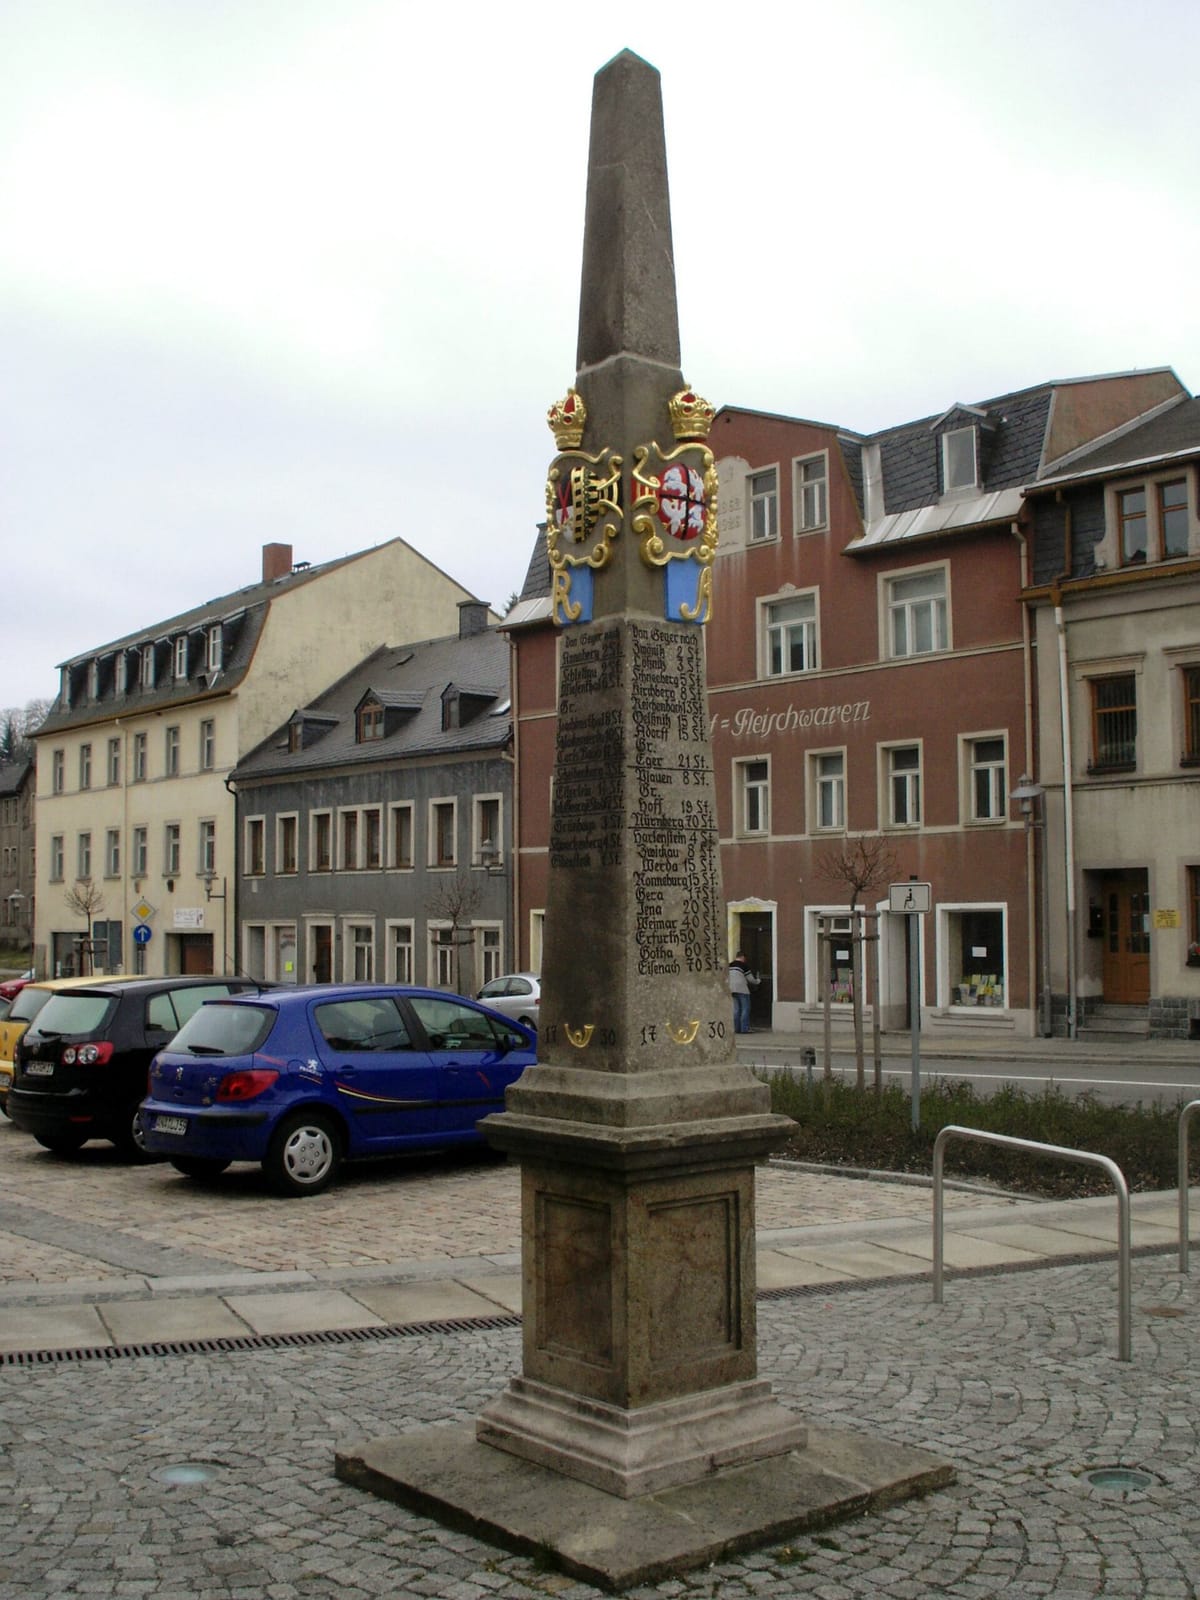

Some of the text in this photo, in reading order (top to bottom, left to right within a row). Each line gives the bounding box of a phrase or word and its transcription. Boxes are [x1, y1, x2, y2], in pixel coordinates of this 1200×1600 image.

[631, 624, 648, 639] Von
[651, 628, 678, 645] Geyer
[677, 645, 683, 658] 2
[687, 646, 701, 660] St.
[677, 658, 683, 672] 3
[687, 659, 702, 673] St.
[680, 673, 687, 686] 5
[688, 673, 703, 688] St.
[680, 687, 687, 700] 8
[689, 687, 704, 701] St.
[682, 701, 692, 714] 13
[692, 701, 706, 715] St.
[677, 714, 688, 728] 15
[692, 715, 706, 729] St.
[731, 701, 871, 738] Fleischwaren
[679, 728, 689, 740] 15
[692, 728, 708, 742] St.
[636, 738, 656, 753] Gr.
[636, 753, 709, 769] Eger 21 St.
[635, 767, 709, 786] Plauen 8 St.
[640, 782, 661, 797] Gr.
[697, 800, 712, 814] St.
[631, 812, 684, 830] Nürnberg
[701, 814, 716, 828] St.
[689, 832, 697, 844] 4
[700, 831, 716, 845] St.
[636, 844, 716, 858] Zwickau 8 St.
[641, 858, 717, 872] Werda 15 St.
[633, 871, 718, 890] Ronneburg 15 St.
[635, 886, 719, 901] Gera 17 St.
[636, 900, 719, 915] Jena 20 St.
[637, 914, 720, 930] Weimar 40 St.
[680, 928, 696, 943] 50
[703, 928, 721, 941] St.
[639, 942, 722, 961] Gotha 60 St.
[638, 957, 723, 976] Eisenach 70 St.
[640, 1020, 726, 1047] 17 30
